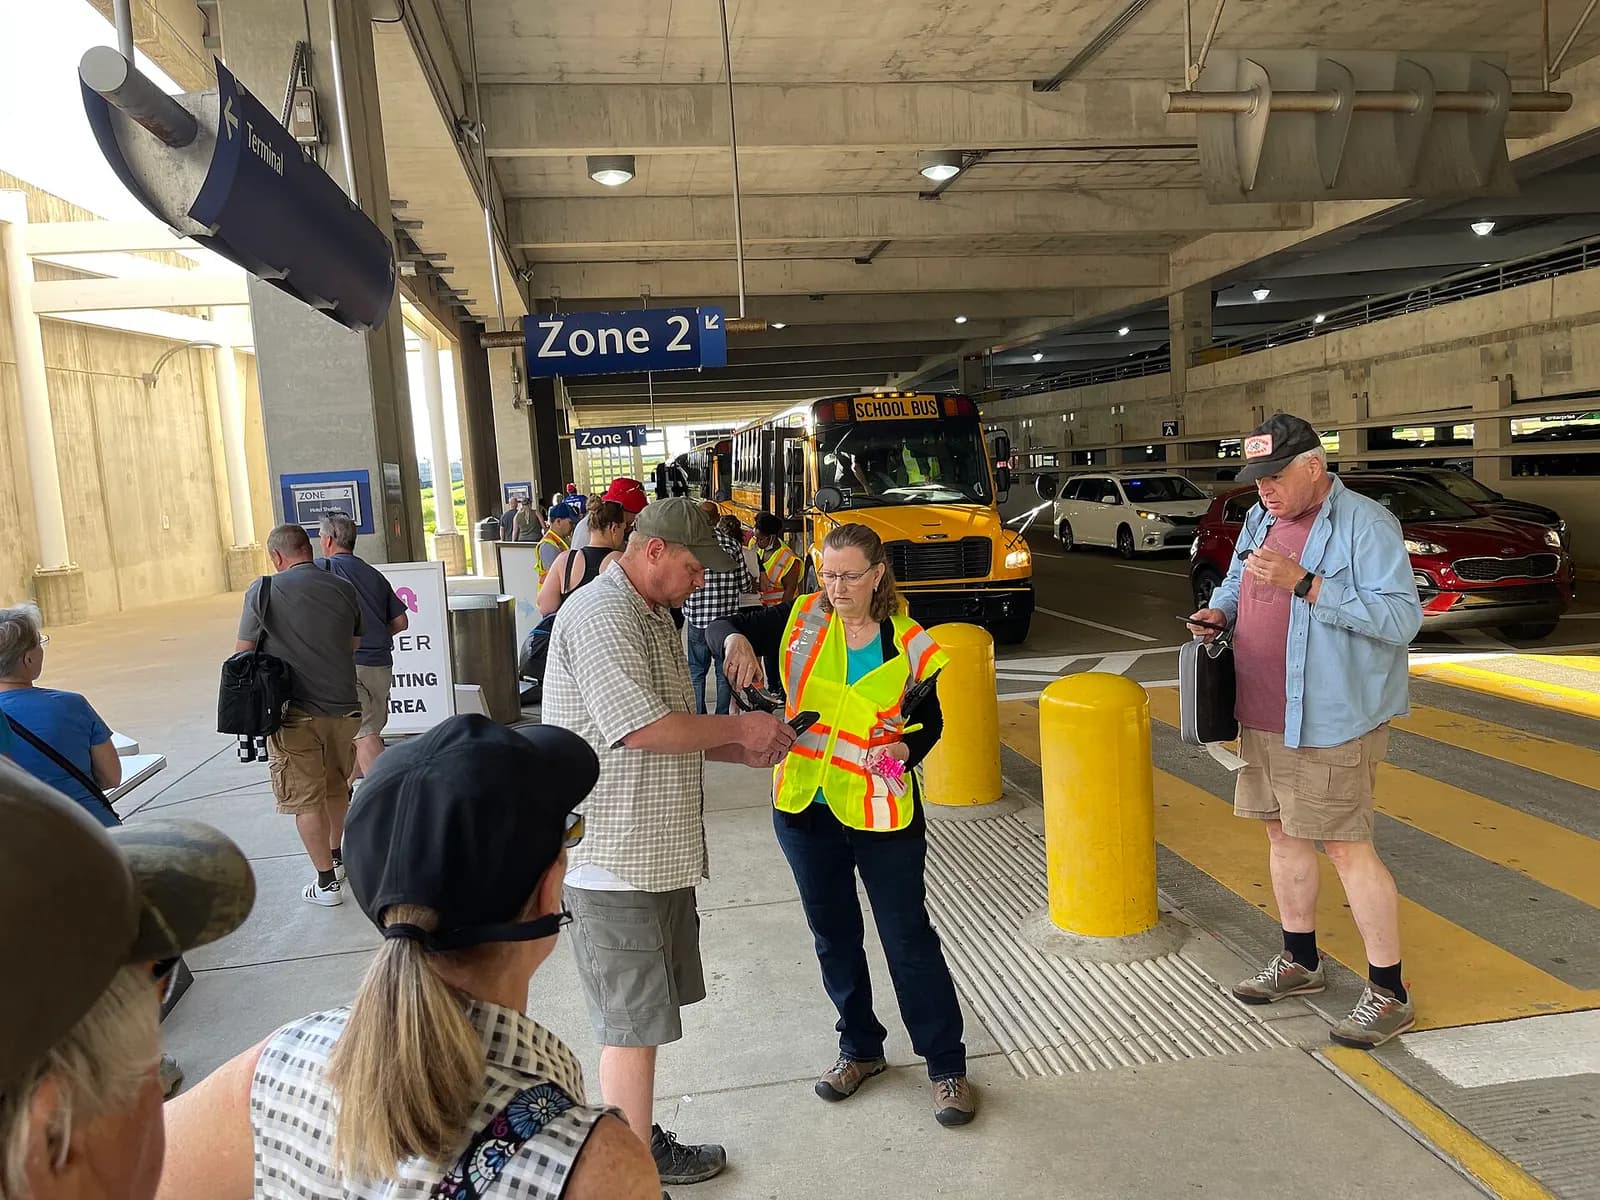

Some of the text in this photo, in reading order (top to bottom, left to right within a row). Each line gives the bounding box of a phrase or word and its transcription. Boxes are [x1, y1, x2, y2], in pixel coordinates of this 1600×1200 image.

[246, 120, 284, 176] Terminal
[537, 315, 691, 358] Zone 2
[855, 400, 937, 418] SCHOOL BUS
[580, 429, 634, 446] Zone 1
[1165, 426, 1174, 436] A
[299, 489, 350, 501] ZONE 2
[391, 635, 431, 651] ER
[391, 672, 438, 688] ITING
[388, 698, 427, 714] REA
